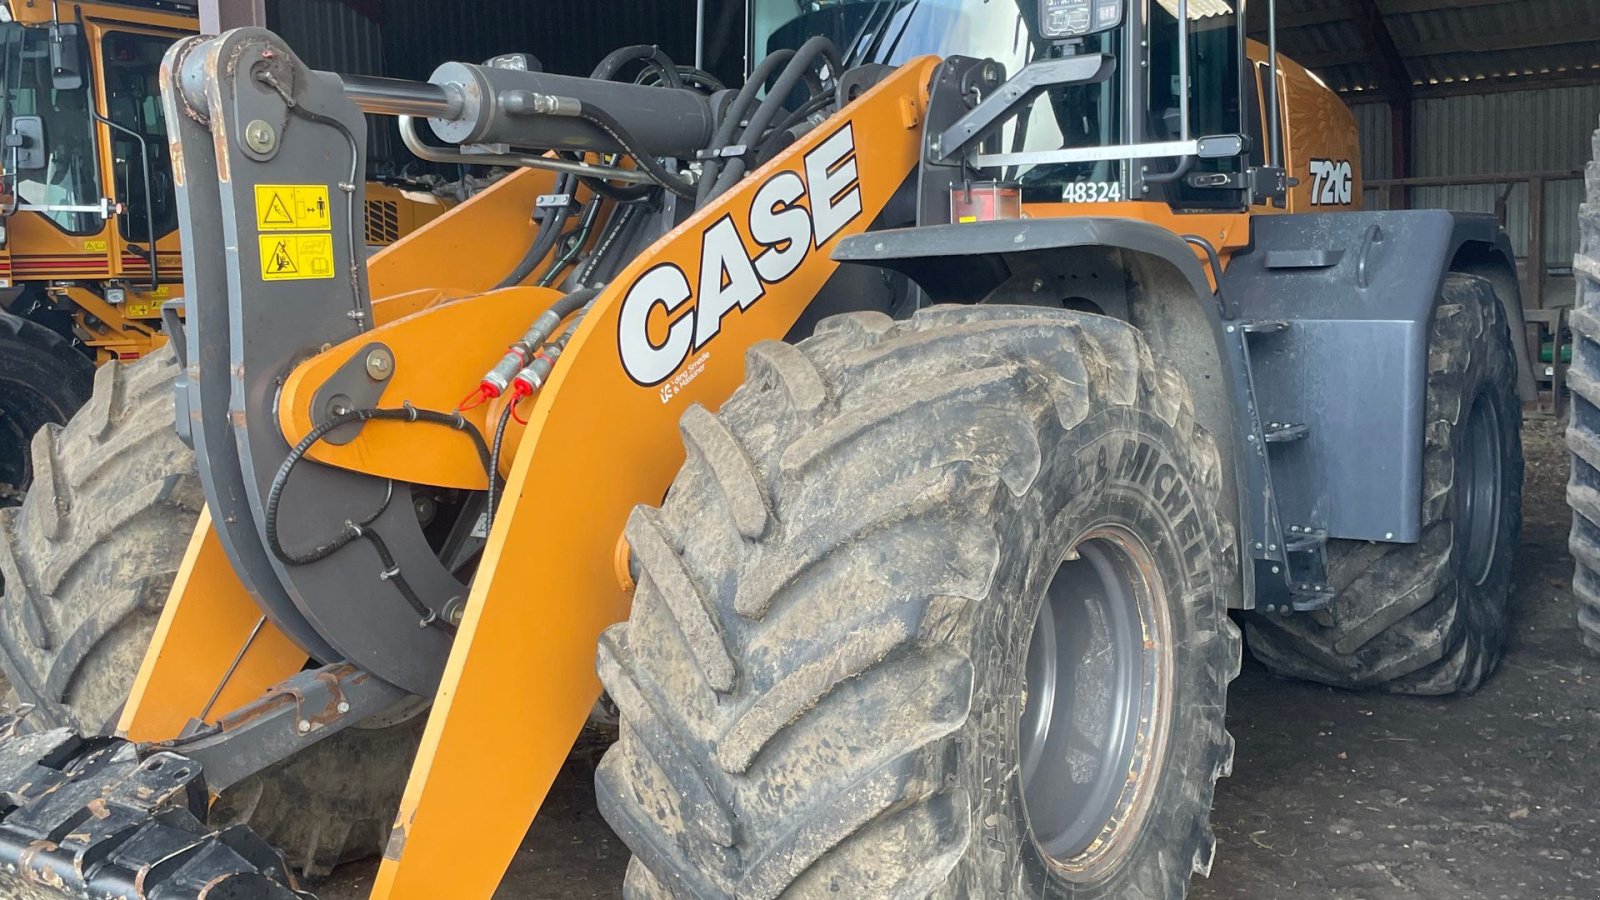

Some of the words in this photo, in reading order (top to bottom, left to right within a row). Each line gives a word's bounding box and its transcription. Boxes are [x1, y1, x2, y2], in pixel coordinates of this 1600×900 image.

[1062, 181, 1121, 203] 48324
[1309, 158, 1352, 206] 721G
[617, 120, 863, 388] CASE
[1112, 438, 1215, 633] MICHELIN
